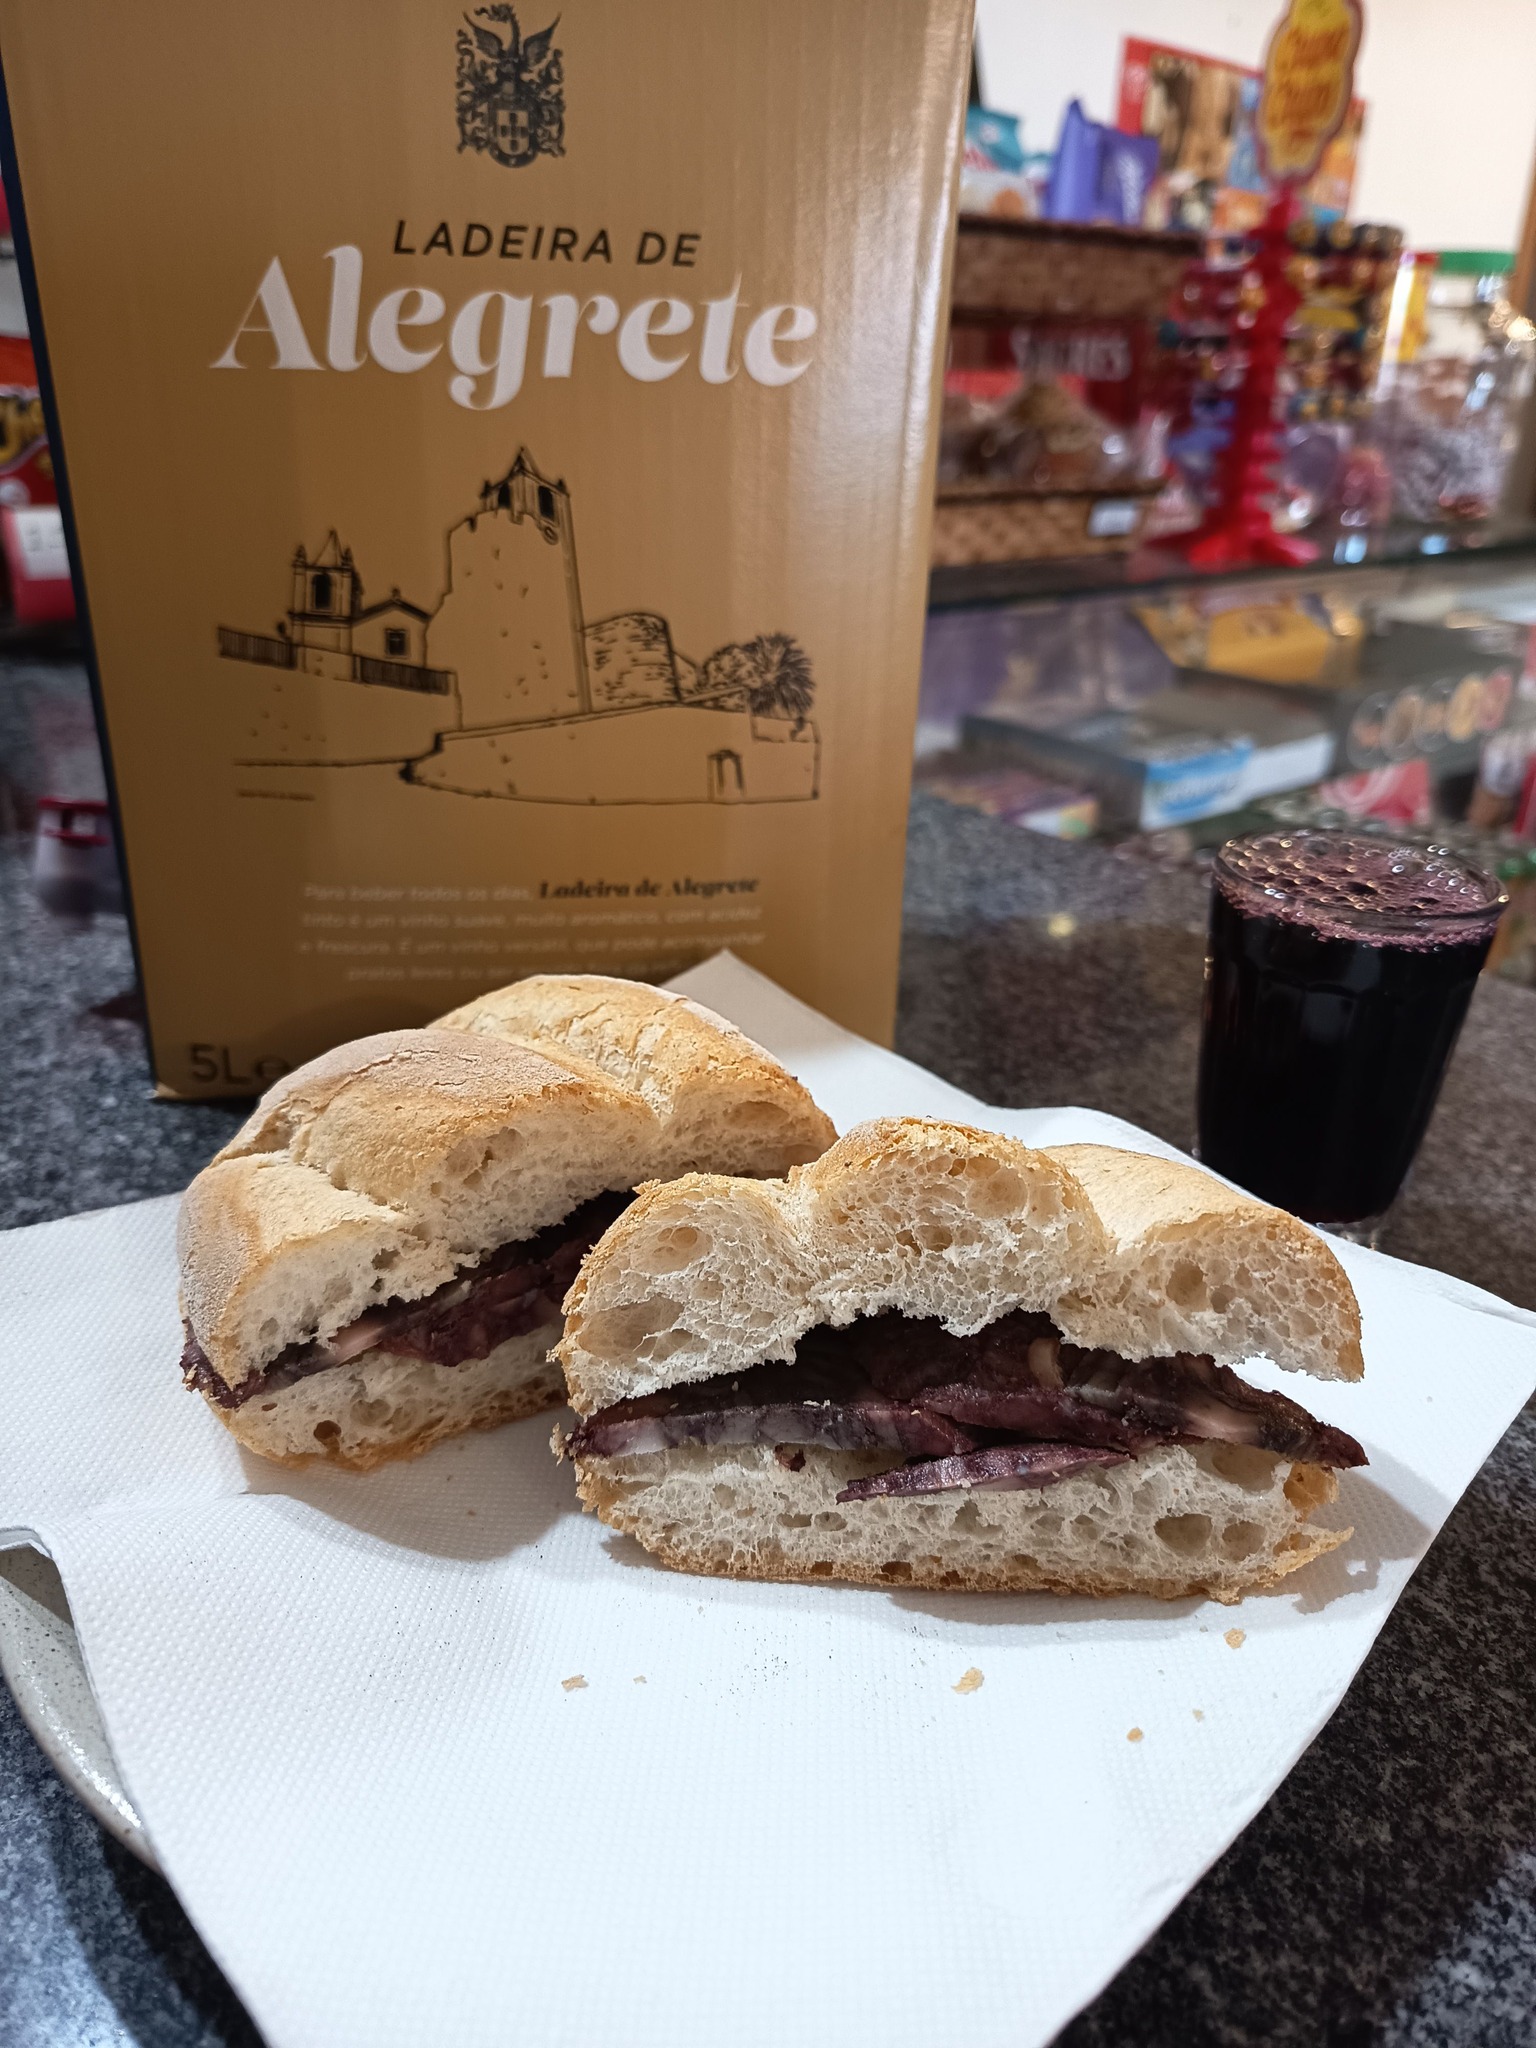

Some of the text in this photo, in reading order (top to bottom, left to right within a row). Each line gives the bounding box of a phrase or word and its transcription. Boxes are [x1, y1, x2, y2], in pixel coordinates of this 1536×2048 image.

[392, 220, 702, 267] LADEIRA DE
[209, 245, 818, 411] Alegrete
[538, 879, 629, 898] Ladeira
[635, 877, 662, 897] de
[665, 876, 760, 898] Alegrete
[189, 1042, 252, 1085] 5L
